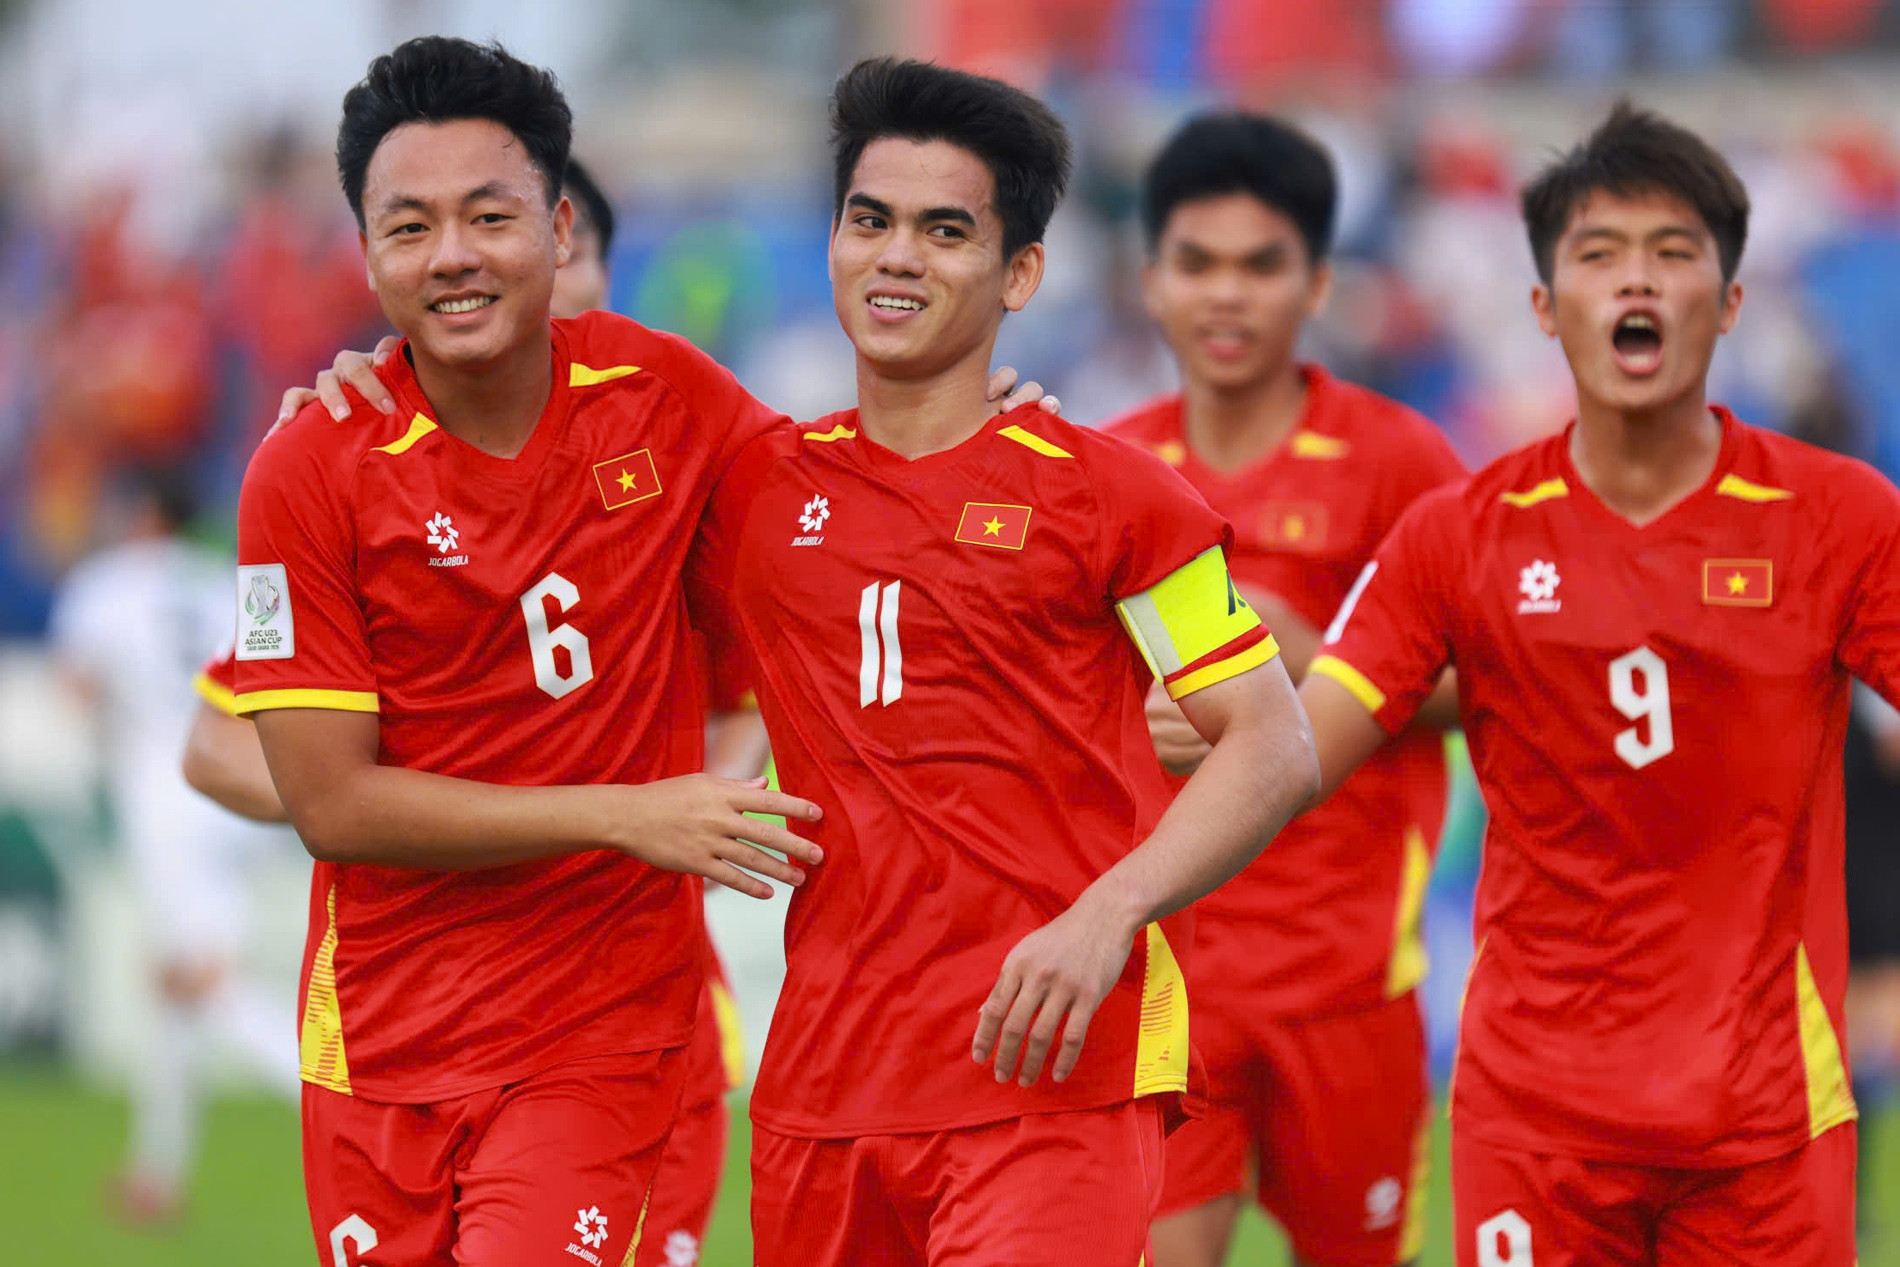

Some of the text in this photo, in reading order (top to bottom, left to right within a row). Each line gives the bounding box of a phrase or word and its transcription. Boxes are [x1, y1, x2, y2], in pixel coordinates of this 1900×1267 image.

[428, 555, 469, 567] JOGARBOLA
[245, 636, 282, 645] ASIAN CUP
[264, 629, 278, 637] U23
[520, 571, 594, 700] 6
[859, 579, 903, 709] 11
[1609, 645, 1674, 770] 9
[564, 1242, 603, 1267] JOGARBOLA
